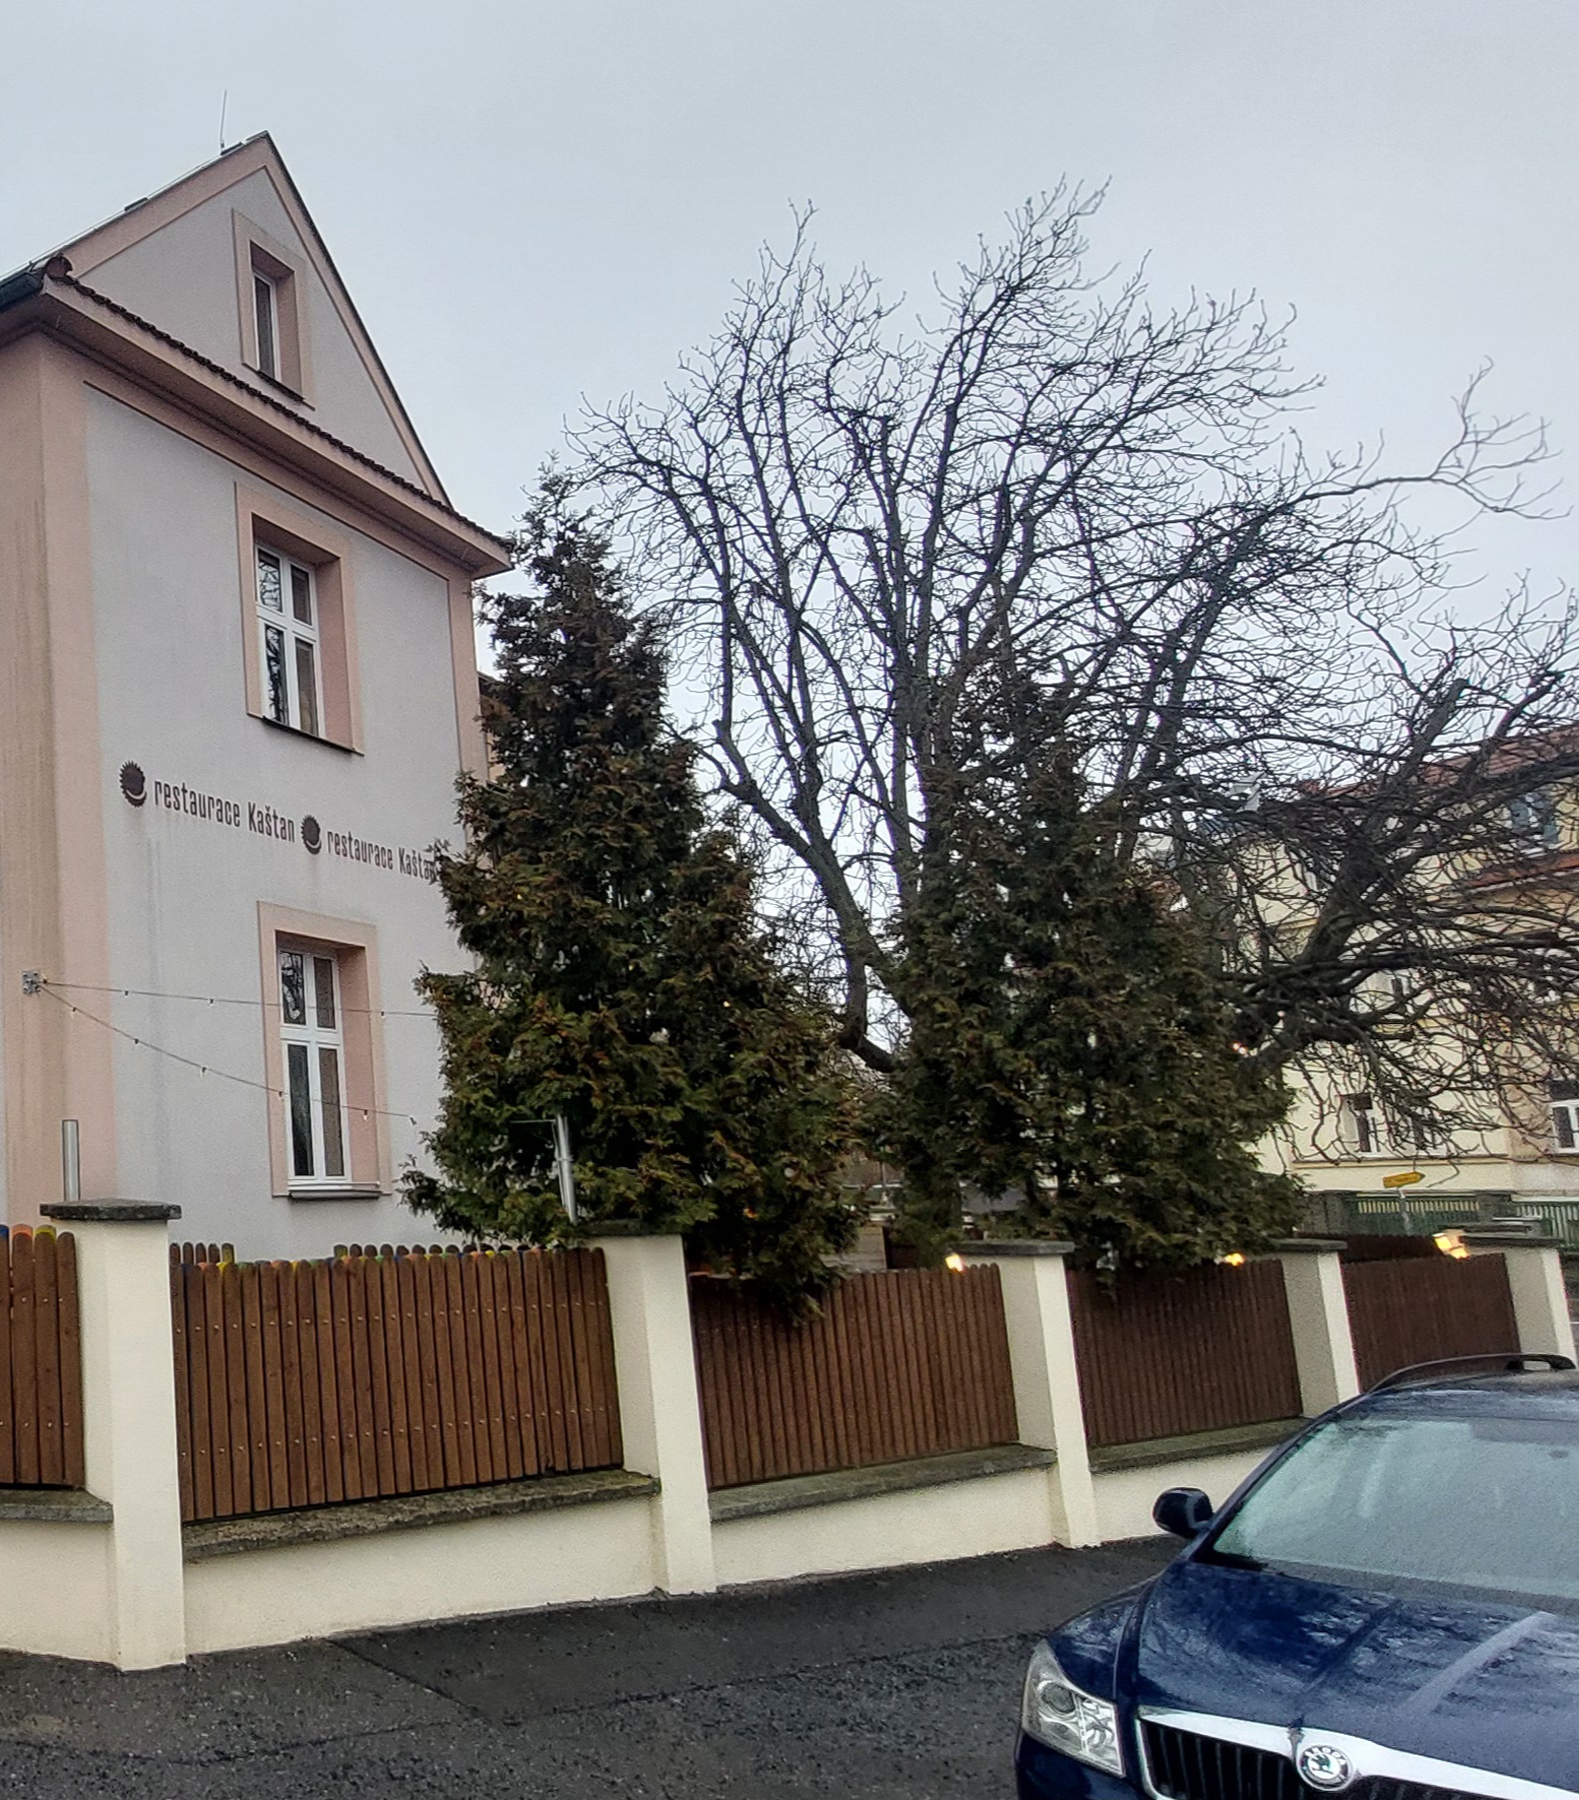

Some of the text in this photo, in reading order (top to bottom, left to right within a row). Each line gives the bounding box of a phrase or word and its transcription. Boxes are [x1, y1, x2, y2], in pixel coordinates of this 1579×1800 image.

[154, 780, 241, 828] restaurace
[248, 801, 295, 843] Kaštan
[327, 830, 393, 870] restaurace
